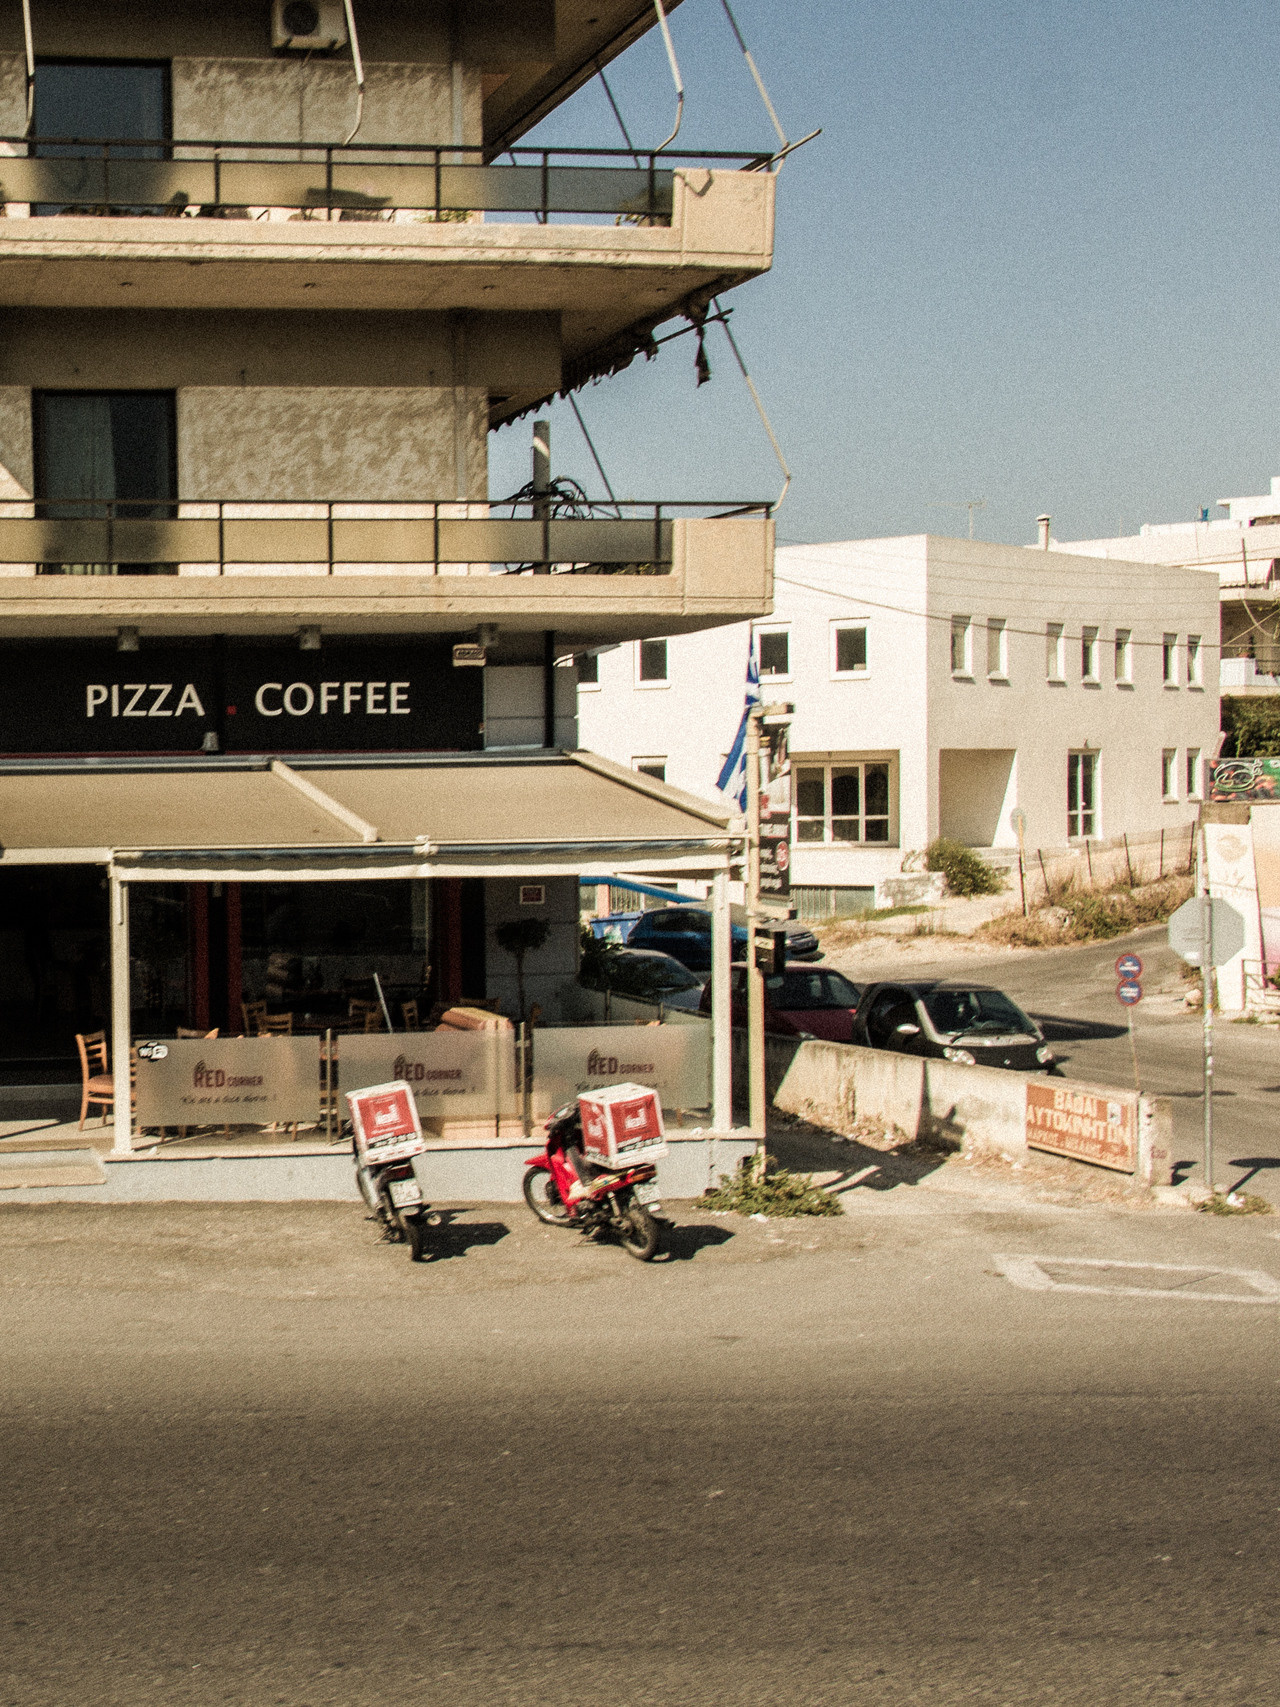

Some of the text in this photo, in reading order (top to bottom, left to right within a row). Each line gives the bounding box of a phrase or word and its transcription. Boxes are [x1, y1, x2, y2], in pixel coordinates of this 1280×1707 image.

[86, 682, 411, 717] PIZZA COFFEE
[394, 1063, 425, 1081] RED
[588, 1057, 654, 1075] RED CORNER
[194, 1069, 225, 1088] RED
